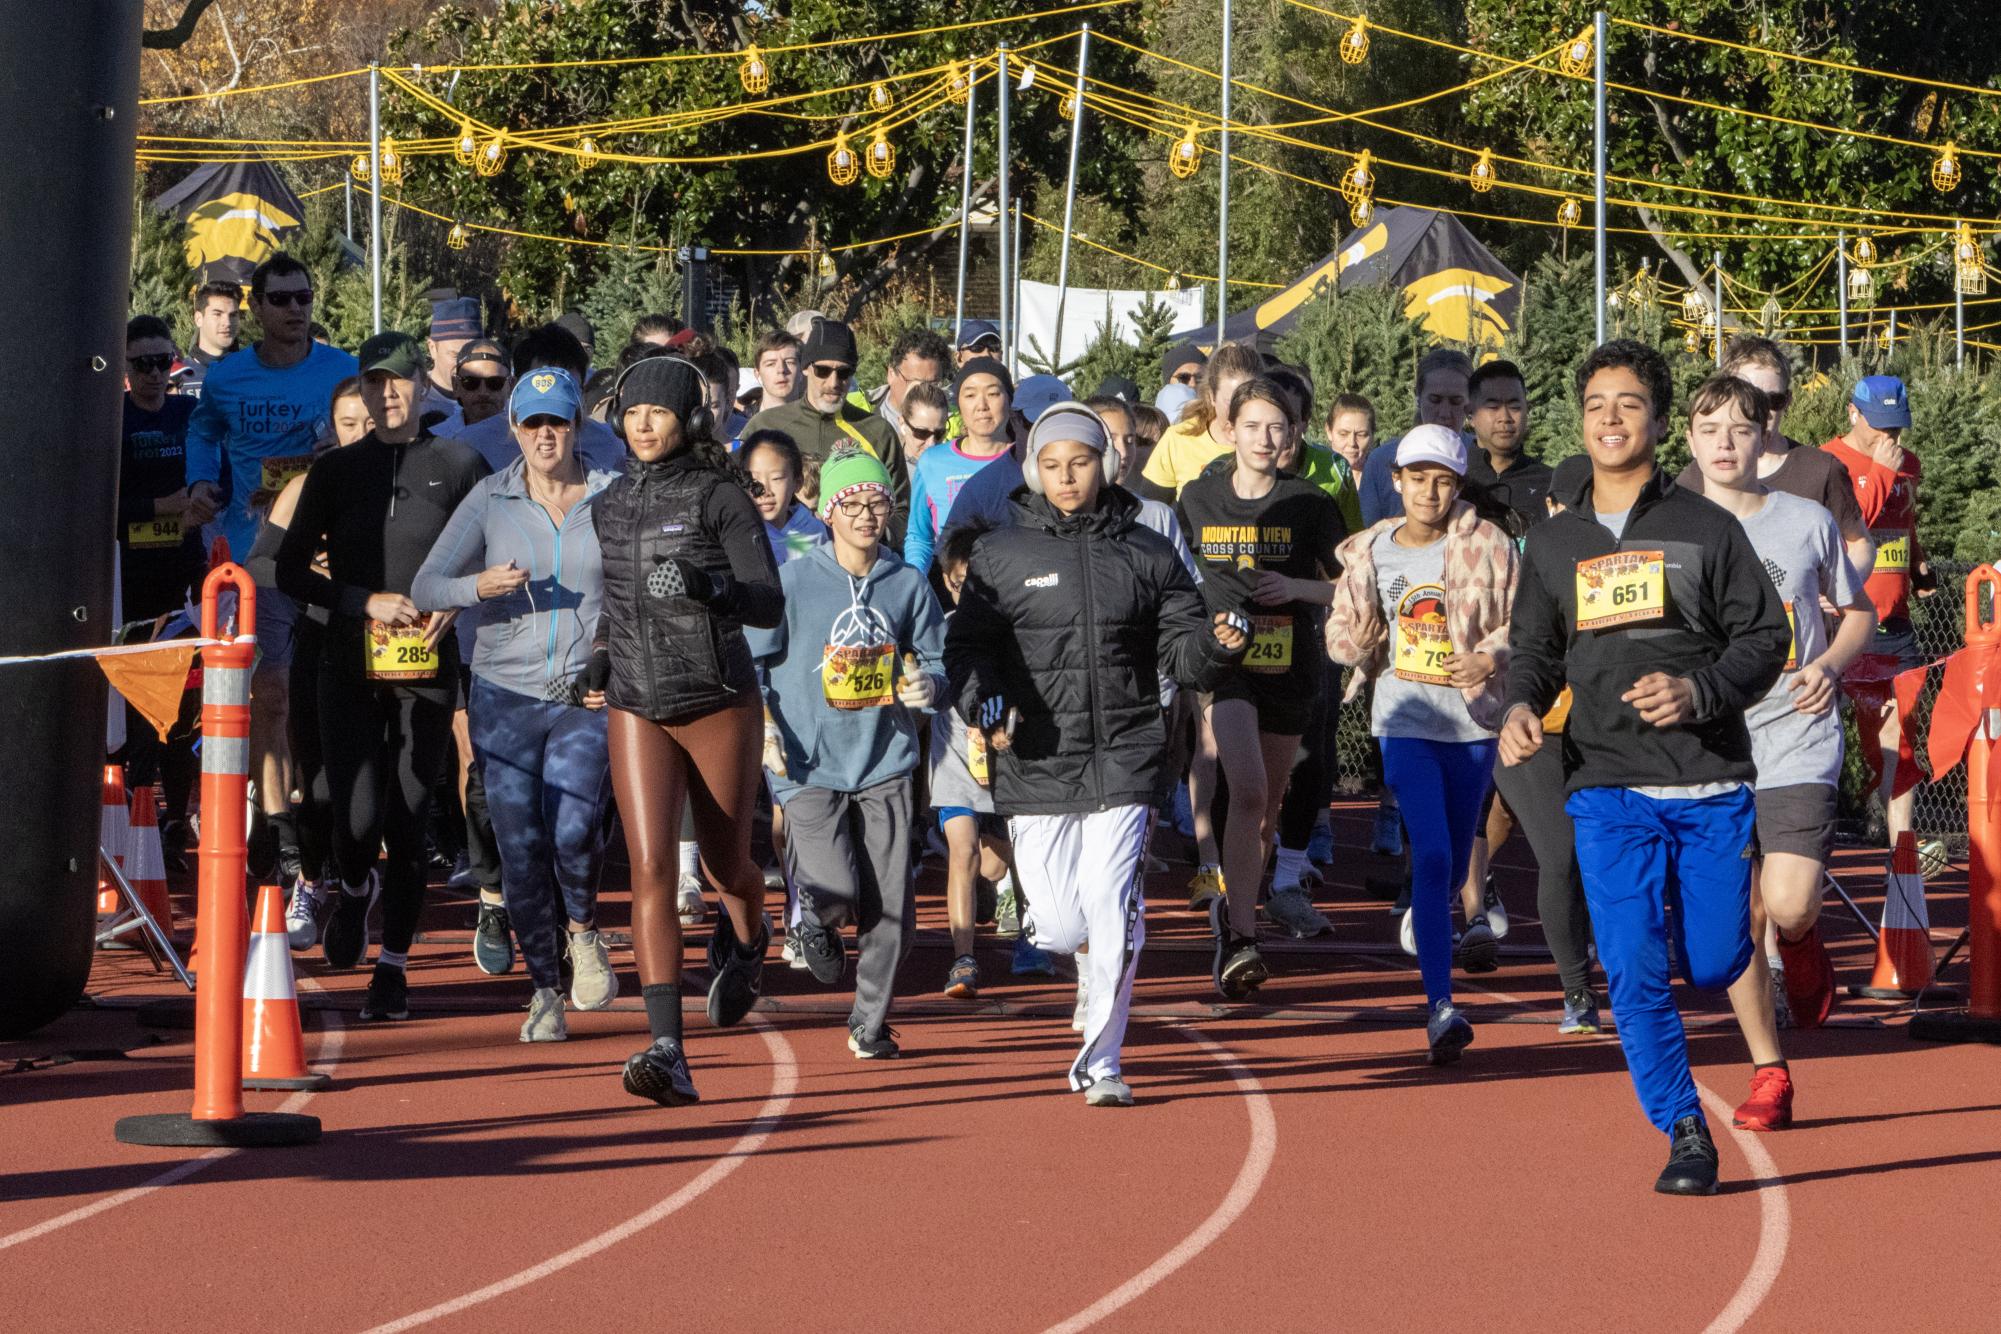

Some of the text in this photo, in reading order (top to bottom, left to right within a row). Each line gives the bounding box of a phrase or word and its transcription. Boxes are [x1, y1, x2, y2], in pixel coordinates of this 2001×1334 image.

[238, 399, 303, 421] Turkey
[238, 417, 271, 433] Trot
[160, 445, 183, 457] 2022
[152, 521, 180, 537] 944
[1202, 526, 1292, 543] MOUNTAIN VIEW
[1201, 543, 1293, 554] CROSS COUNTRY
[1884, 548, 1909, 562] 1012
[1589, 554, 1649, 571] SPARTAN
[1612, 581, 1649, 606] 651
[1408, 622, 1449, 634] SPARTA
[397, 646, 430, 663] 285
[1251, 642, 1283, 660] 243
[854, 672, 884, 693] 526
